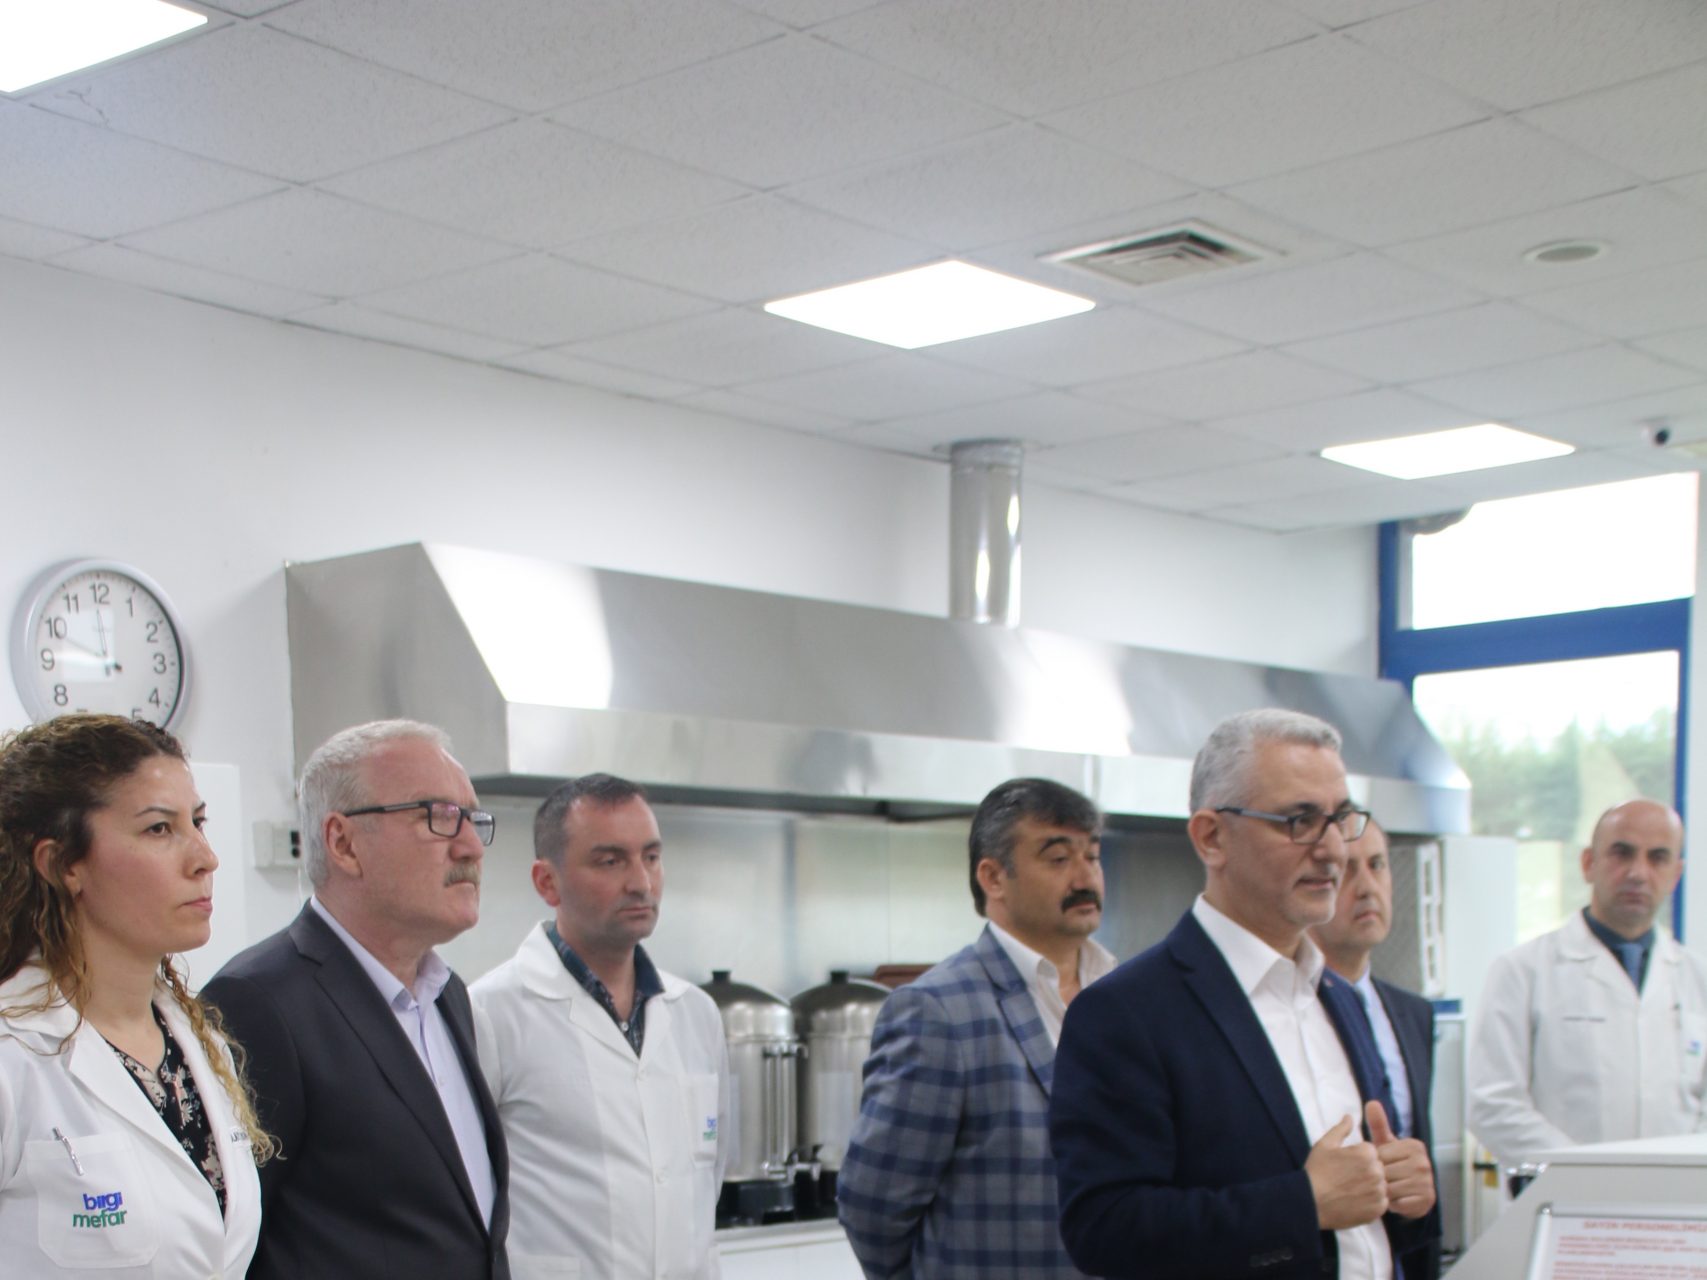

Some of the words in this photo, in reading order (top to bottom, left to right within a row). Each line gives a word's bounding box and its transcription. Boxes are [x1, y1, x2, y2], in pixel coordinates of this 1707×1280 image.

[63, 593, 80, 613] 11
[89, 583, 110, 604] 12
[126, 597, 134, 617] 1
[45, 617, 67, 639] 10
[146, 621, 159, 643] 2
[40, 648, 55, 671] 9
[153, 653, 167, 674] 3
[54, 684, 69, 706] 8
[148, 688, 160, 708] 4
[73, 1209, 127, 1228] mefar
